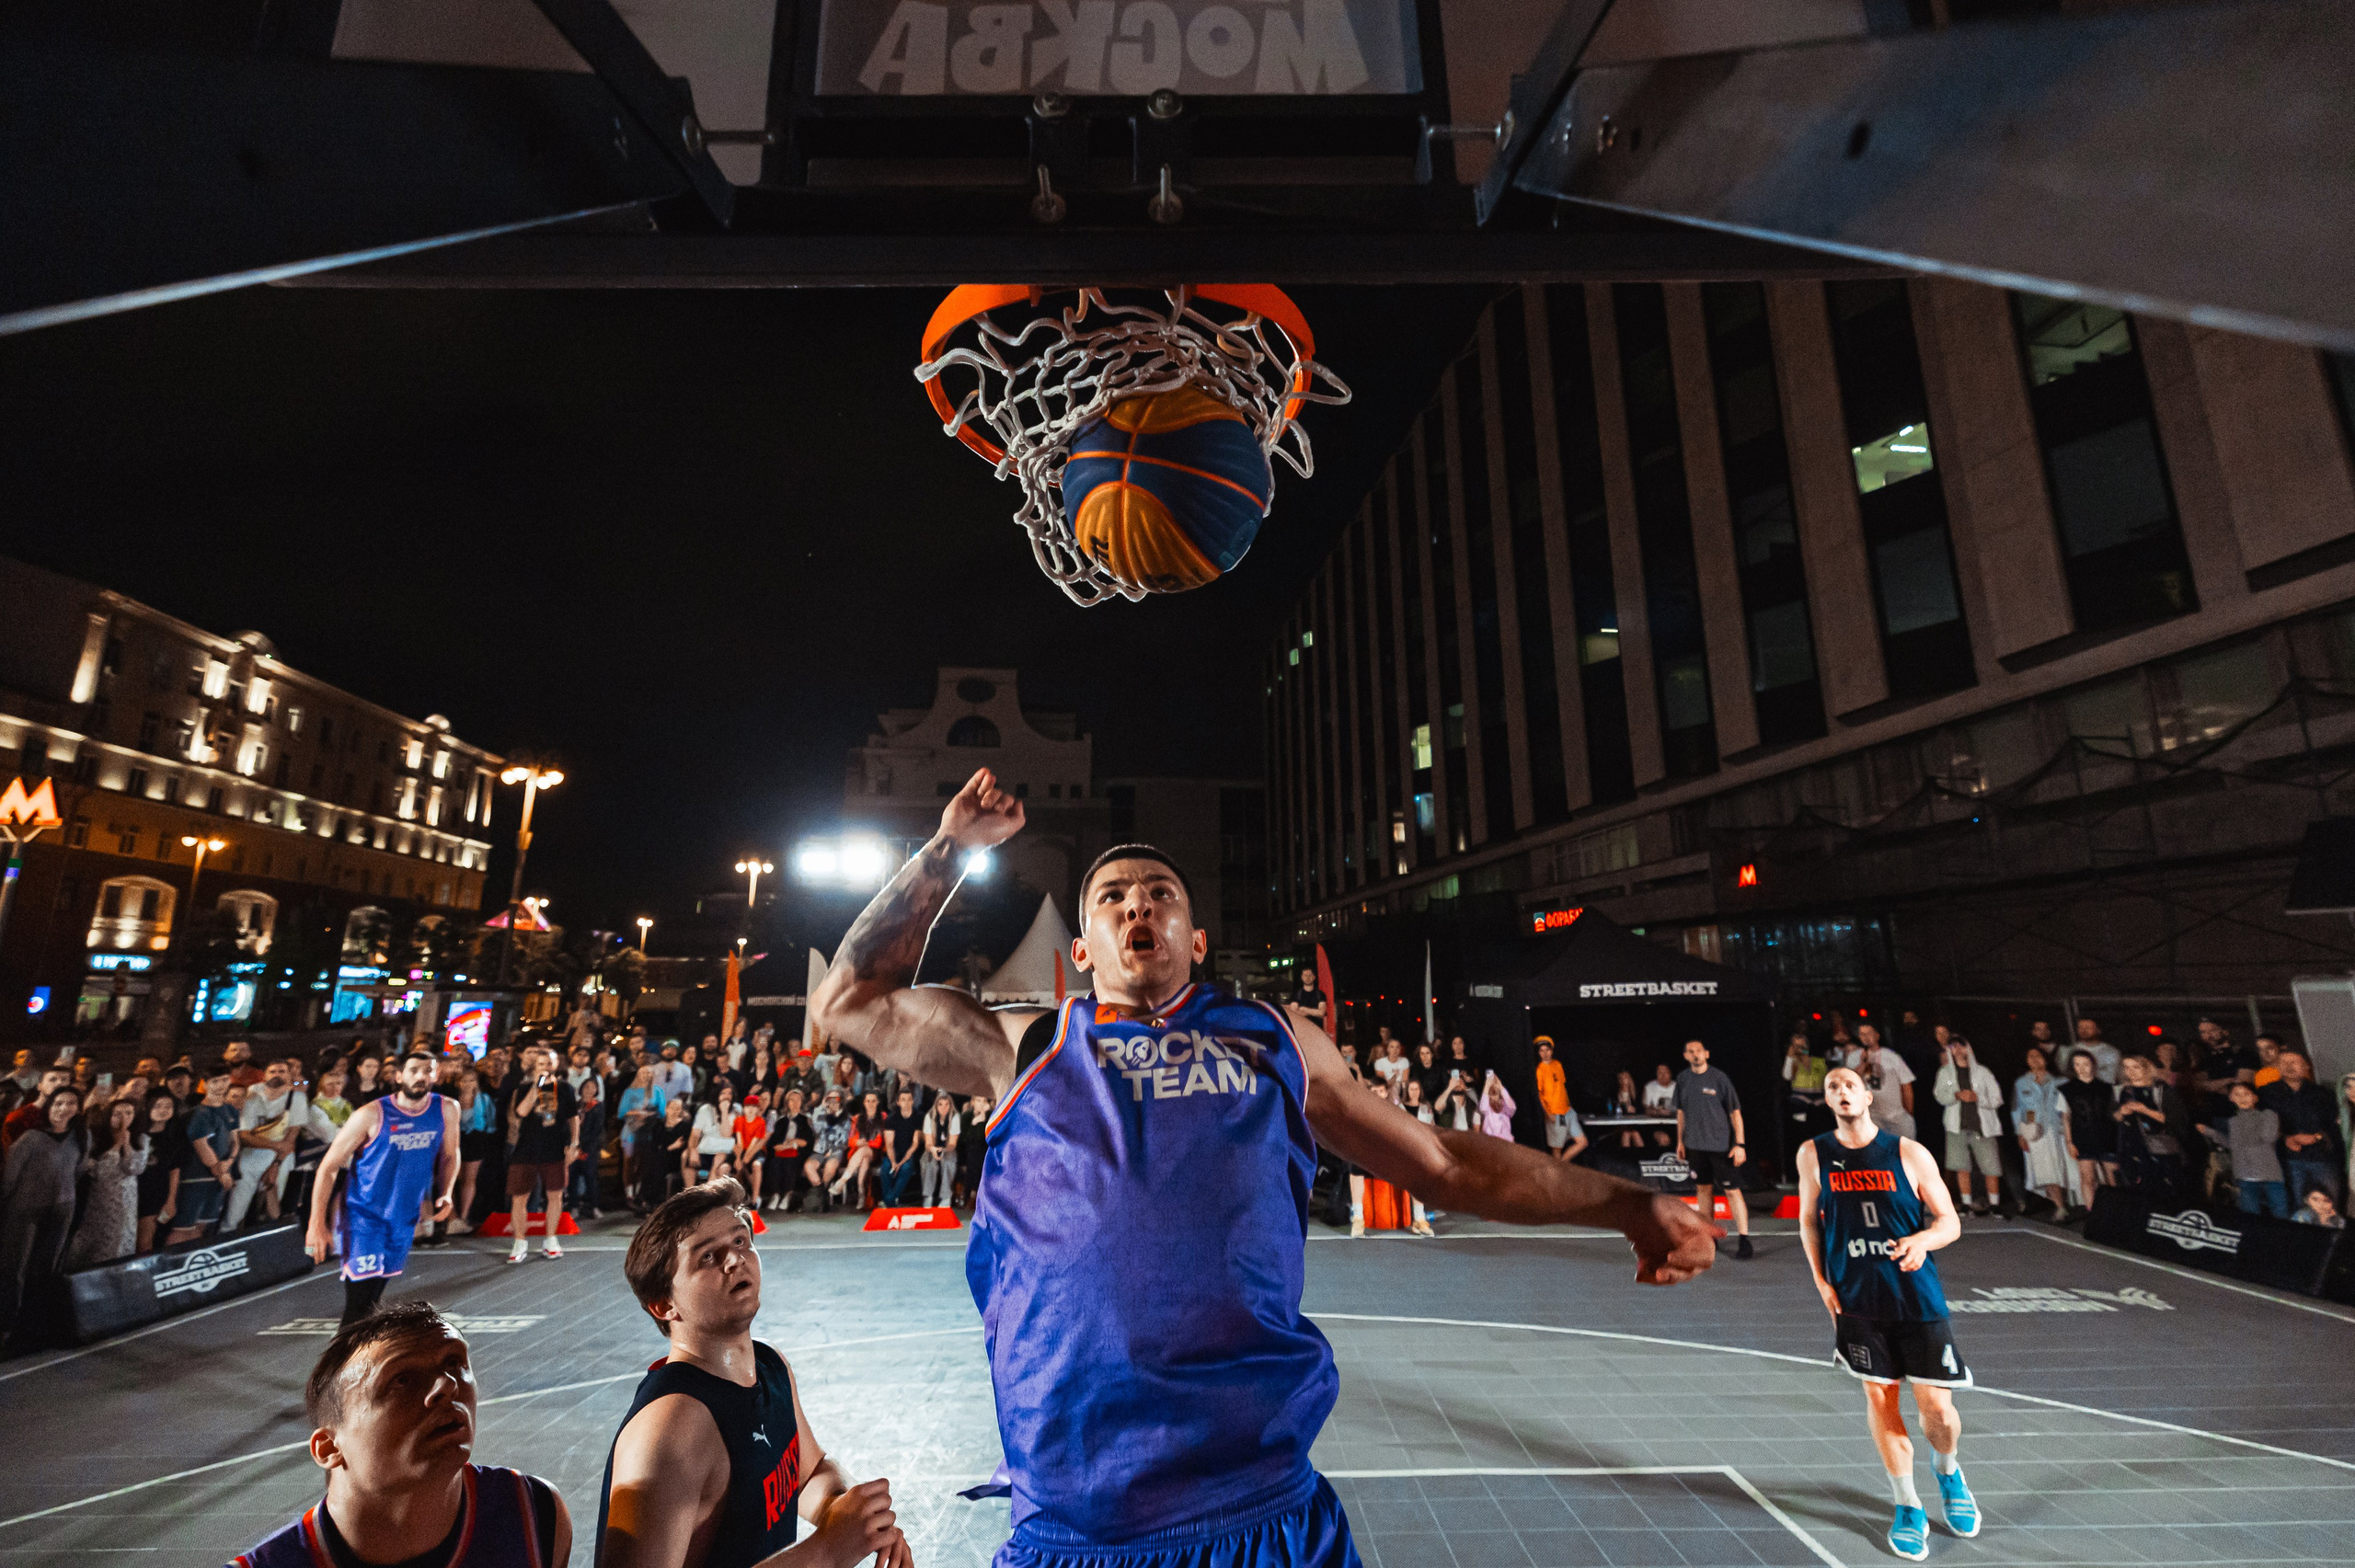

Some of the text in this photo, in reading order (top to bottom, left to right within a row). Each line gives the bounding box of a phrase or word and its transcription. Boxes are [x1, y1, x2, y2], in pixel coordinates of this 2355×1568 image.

[1579, 981, 1718, 999] STREETBASKET
[1121, 1059, 1257, 1102] TEAM
[1829, 1170, 1897, 1192] RUSSIA
[356, 1253, 377, 1274] 32
[1941, 1344, 1959, 1374] 4
[763, 1430, 800, 1532] RUSS
